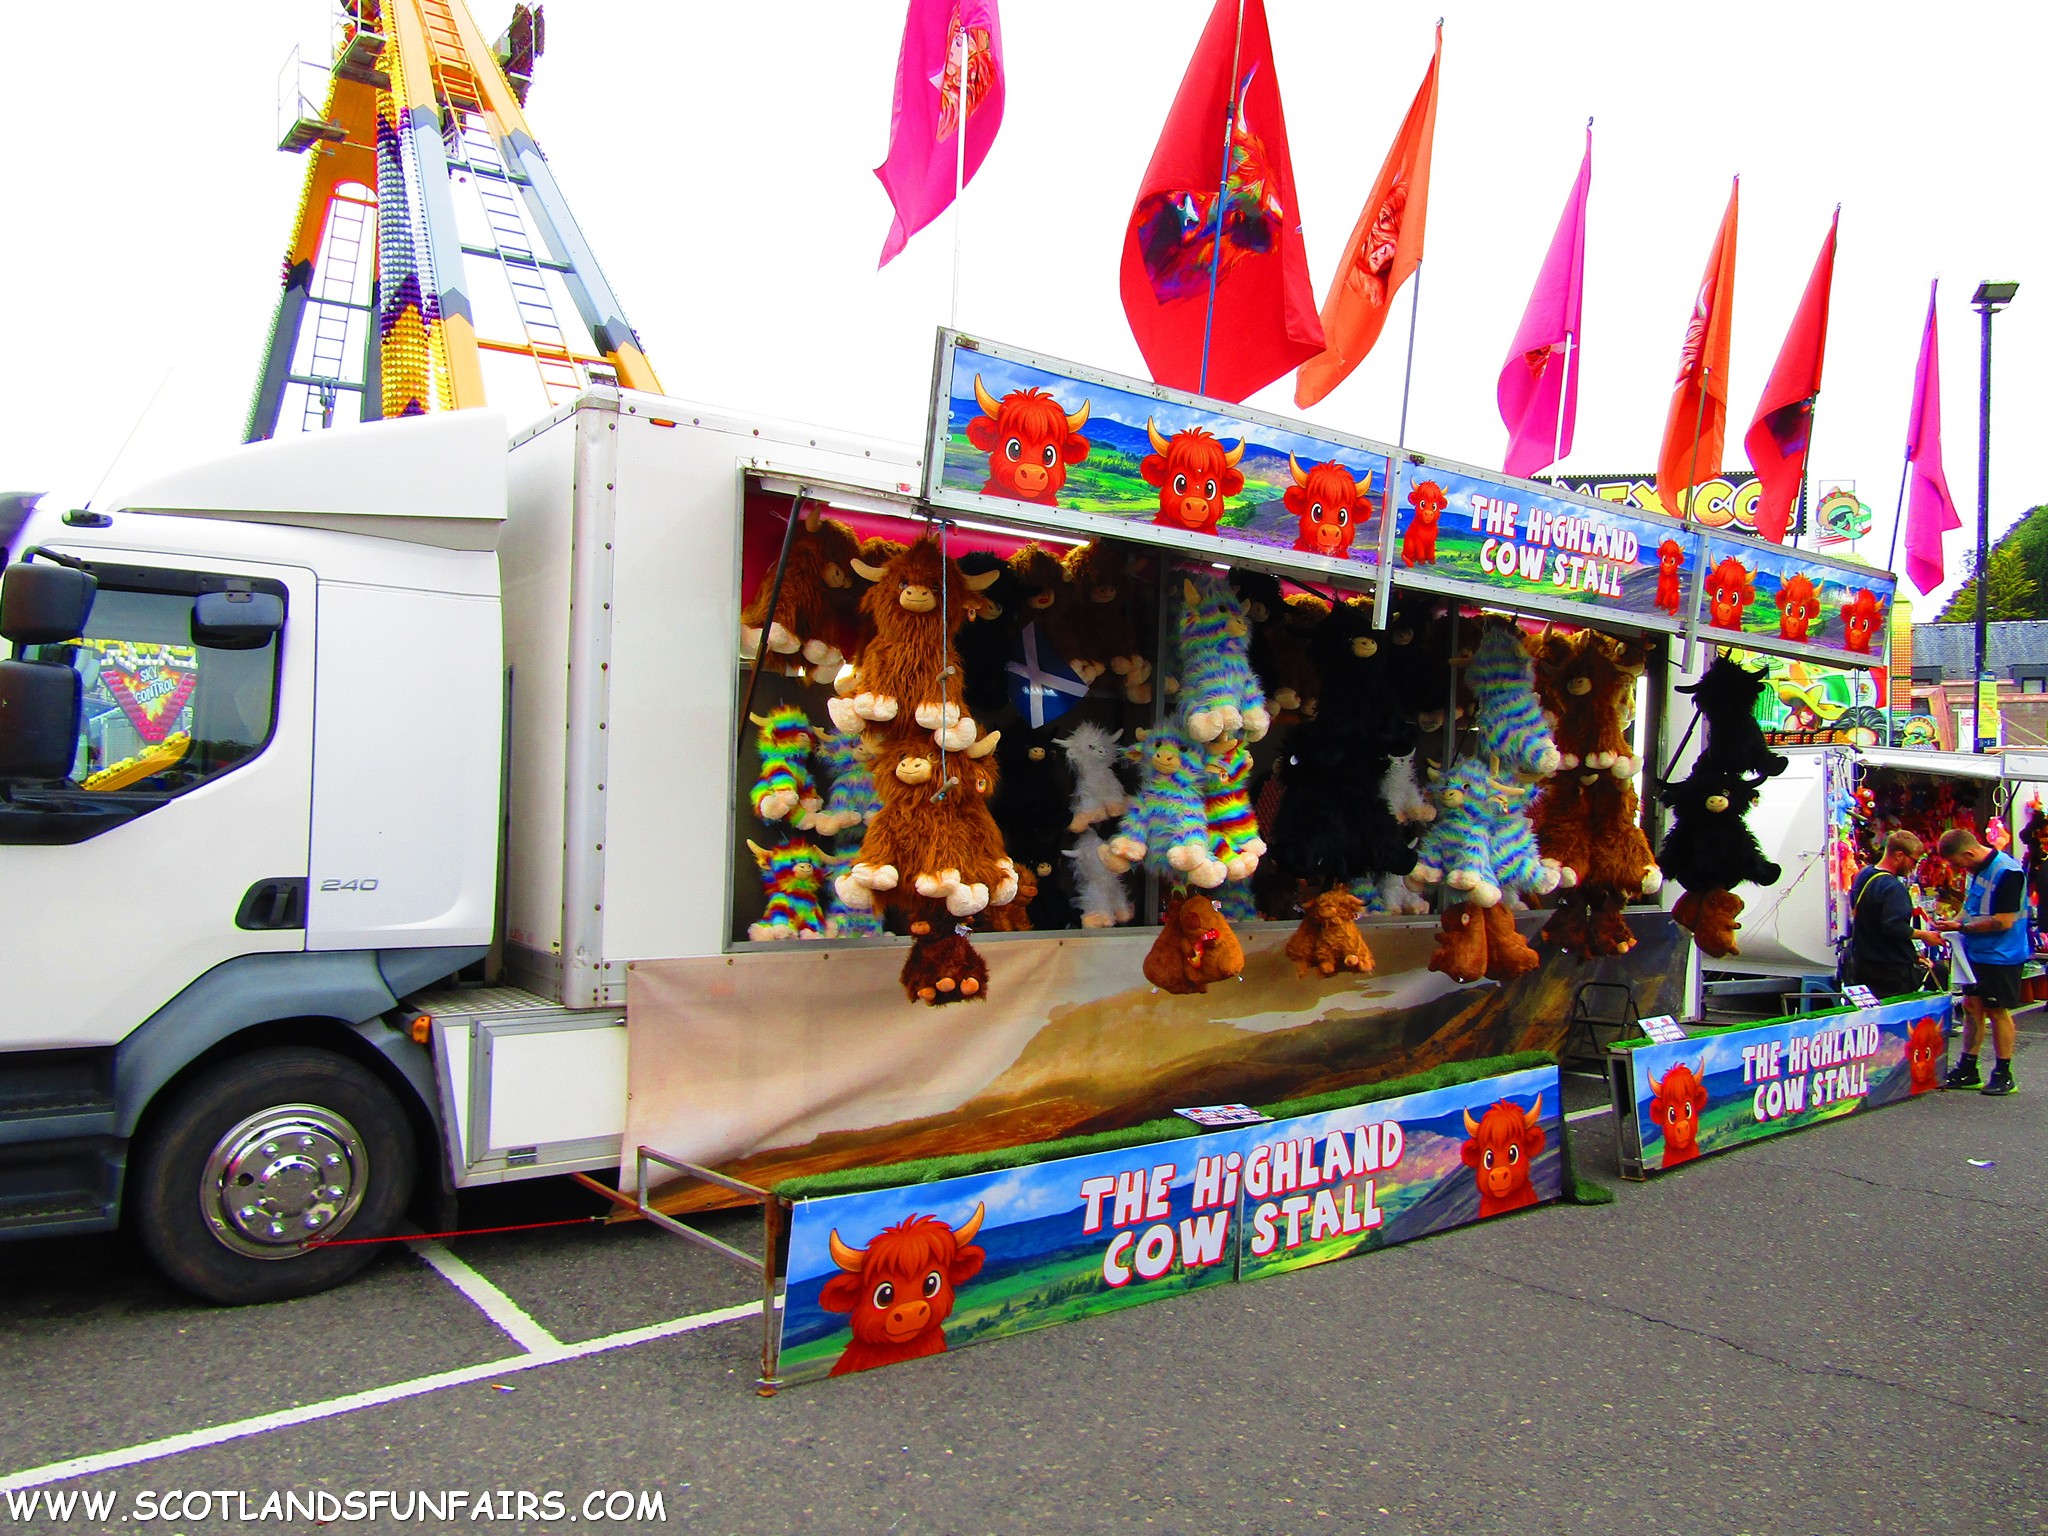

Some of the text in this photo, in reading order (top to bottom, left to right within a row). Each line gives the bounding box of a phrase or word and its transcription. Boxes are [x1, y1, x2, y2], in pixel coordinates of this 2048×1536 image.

[1471, 494, 1519, 538] THE
[1480, 538, 1622, 598] COW STALL
[135, 678, 176, 704] CONTROL
[140, 666, 158, 682] SKY
[320, 878, 379, 892] 240
[1742, 1040, 1782, 1085] THE
[1753, 1062, 1870, 1123] COW STALL
[1080, 1163, 1177, 1235] THE
[1102, 1179, 1383, 1288] COW STALL
